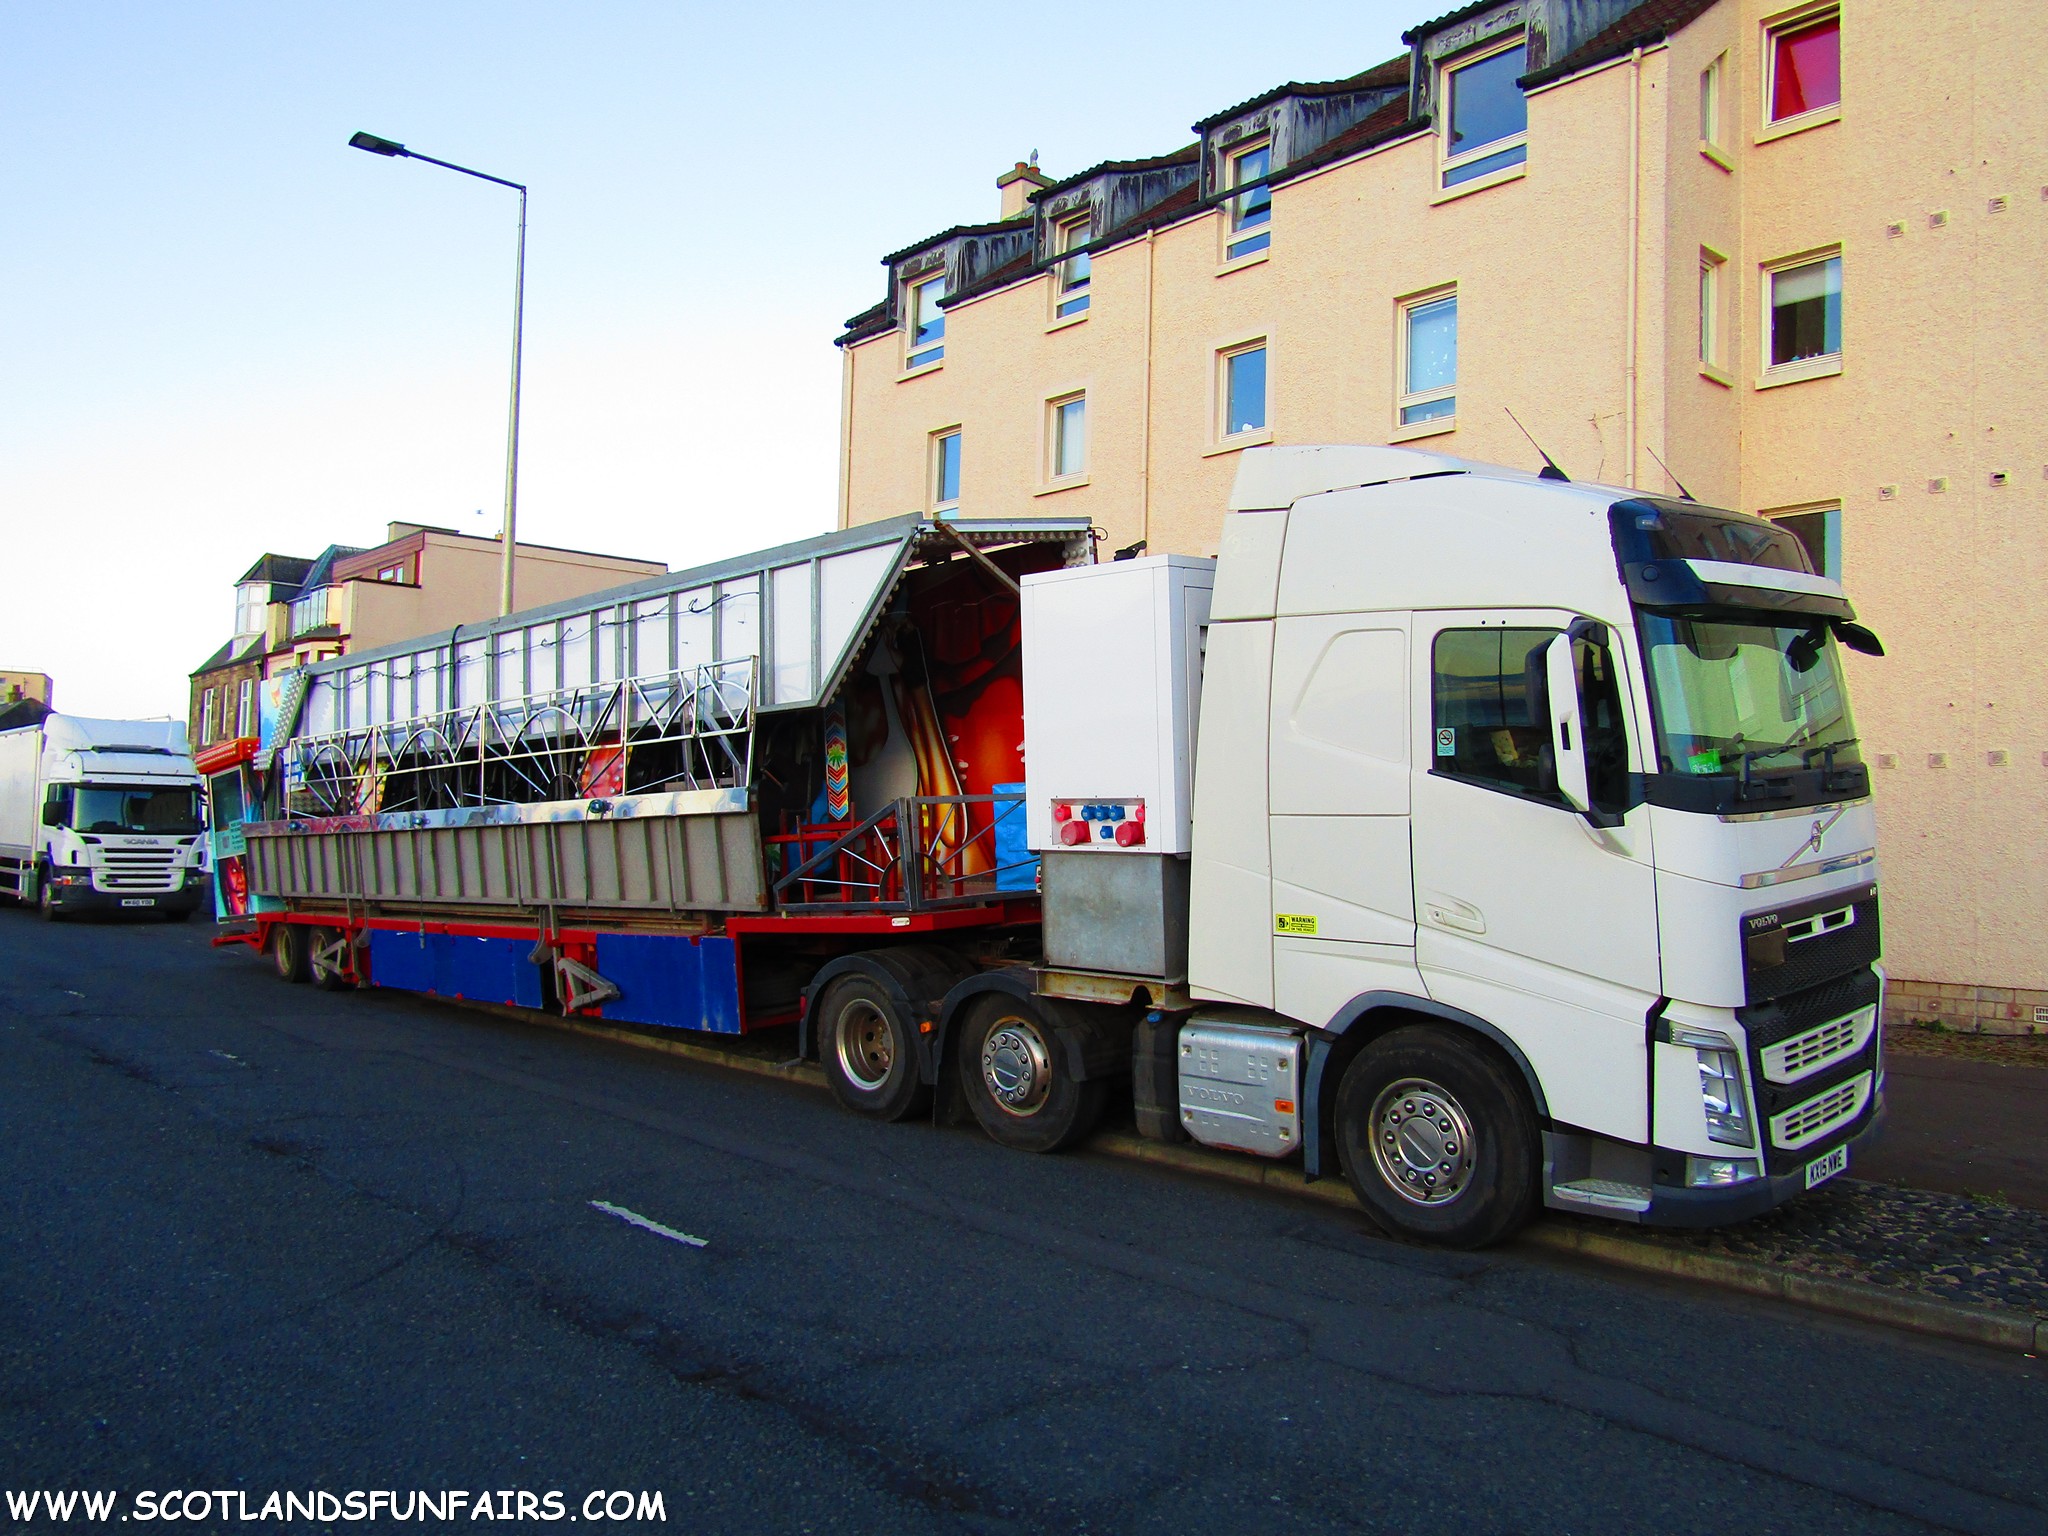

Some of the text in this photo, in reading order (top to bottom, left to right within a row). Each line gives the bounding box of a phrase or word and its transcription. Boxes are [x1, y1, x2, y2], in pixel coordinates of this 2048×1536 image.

[1290, 916, 1315, 924] WARNING
[1748, 913, 1778, 929] VOLVO
[1183, 1084, 1246, 1106] VOLVO
